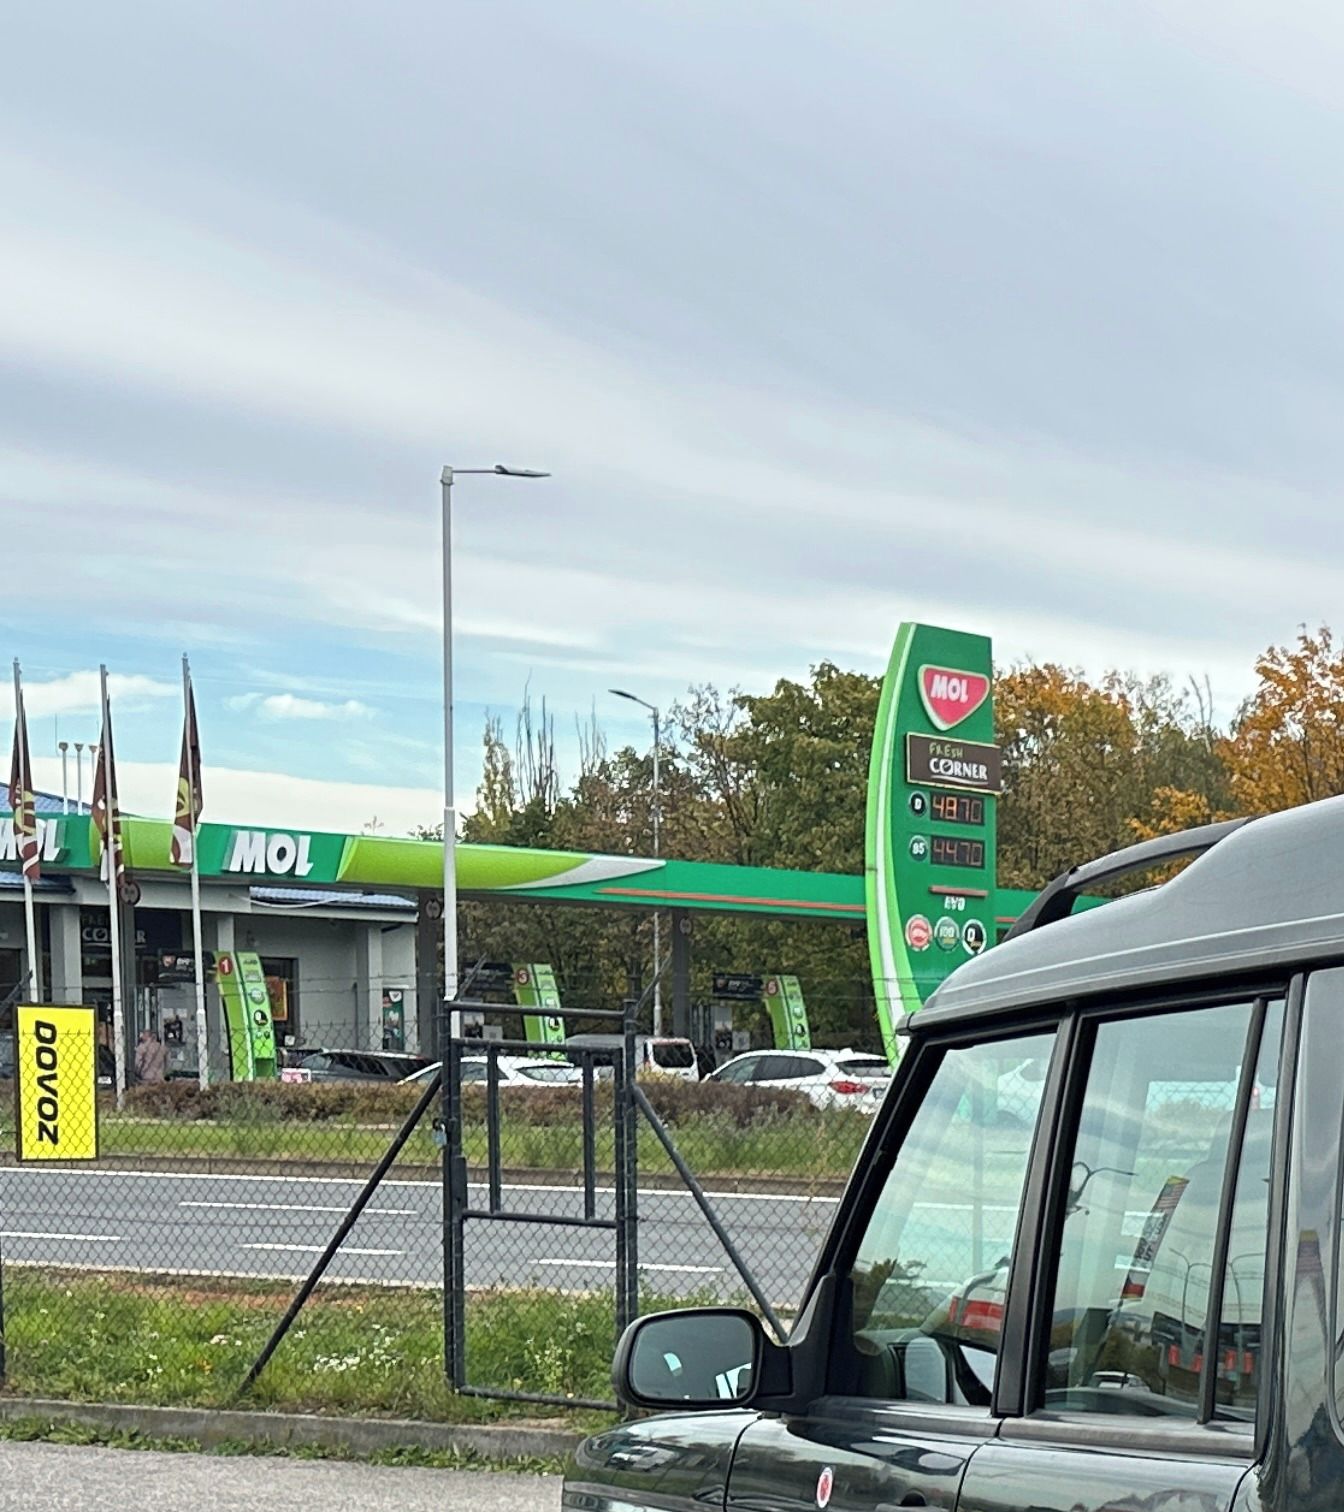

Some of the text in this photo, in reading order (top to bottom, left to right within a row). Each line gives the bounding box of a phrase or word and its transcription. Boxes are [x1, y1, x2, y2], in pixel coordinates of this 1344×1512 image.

[930, 673, 969, 704] MOL
[928, 742, 964, 759] FRESH
[928, 758, 988, 780] CORNER
[0, 817, 61, 861] ML
[228, 829, 314, 877] MOL
[82, 926, 147, 943] COR
[35, 1019, 59, 1146] DOVOZ
